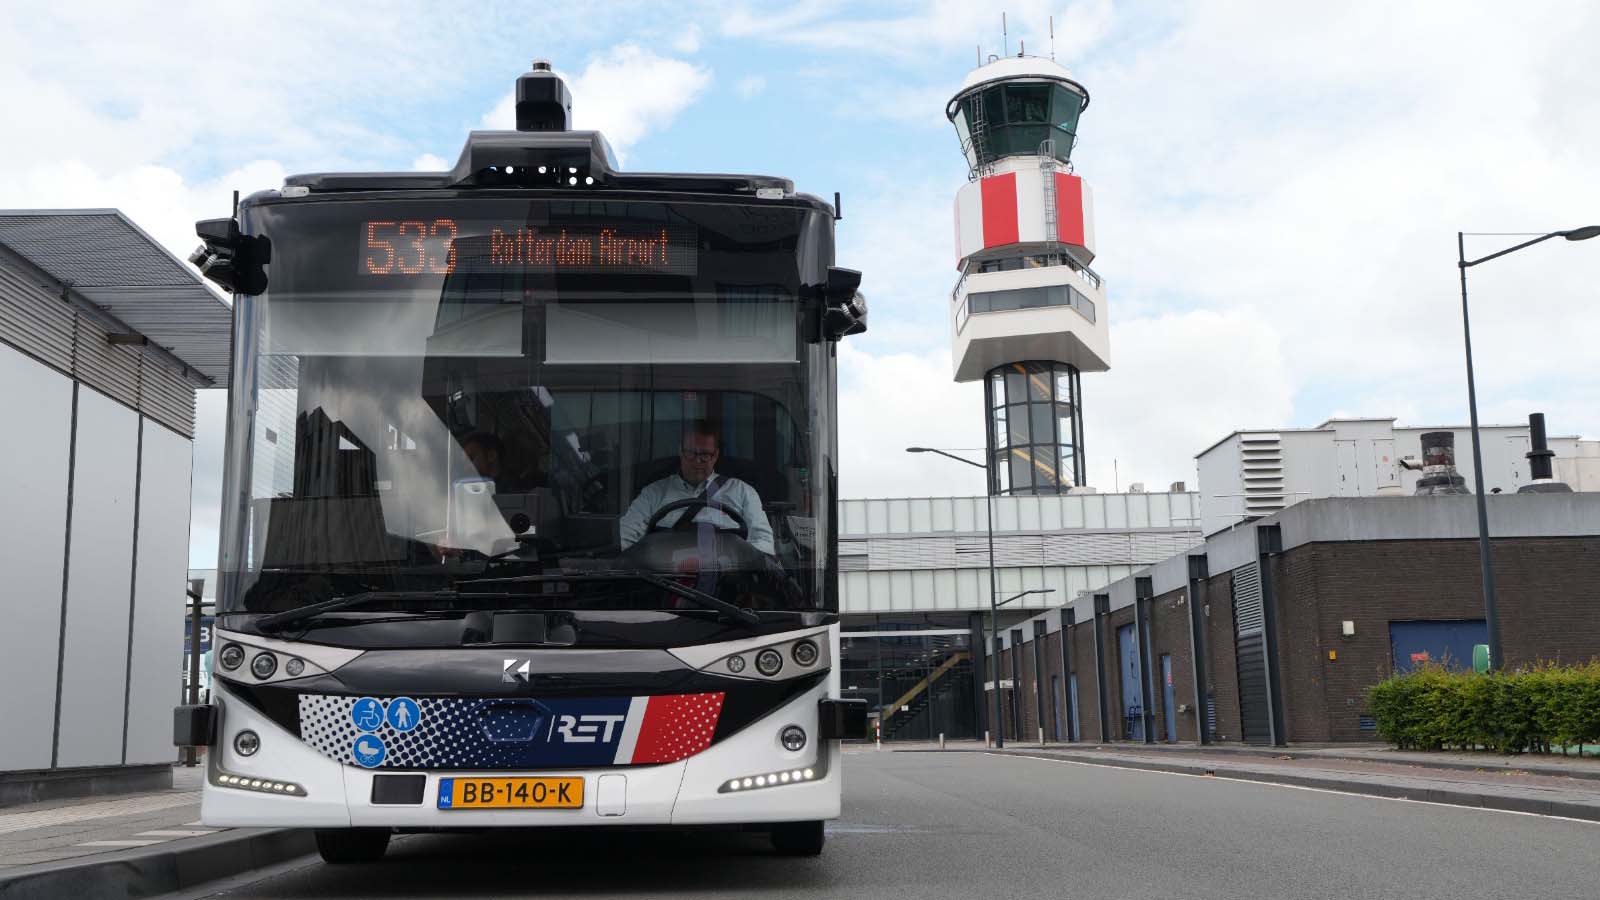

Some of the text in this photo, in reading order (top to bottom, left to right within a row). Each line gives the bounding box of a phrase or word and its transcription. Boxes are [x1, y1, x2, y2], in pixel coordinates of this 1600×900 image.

[367, 219, 669, 274] 533 Rotterdam Airport
[558, 715, 625, 743] RET
[440, 796, 451, 804] NL
[463, 782, 572, 803] BB-140-K
